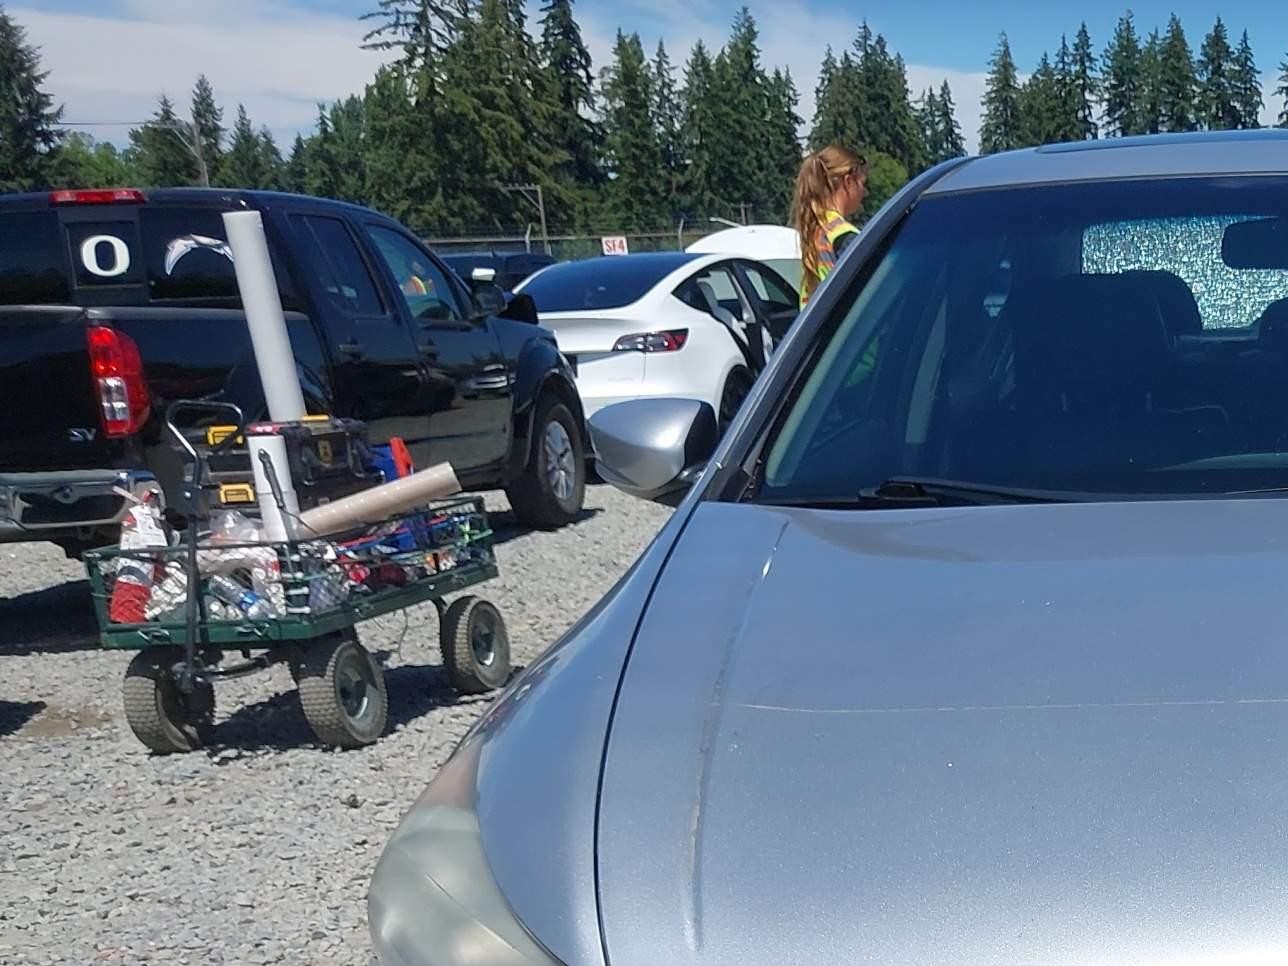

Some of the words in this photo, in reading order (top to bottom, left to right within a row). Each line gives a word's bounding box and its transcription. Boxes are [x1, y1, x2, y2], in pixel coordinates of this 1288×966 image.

[604, 239, 625, 253] SF4
[81, 234, 131, 277] O
[69, 427, 97, 441] SV
